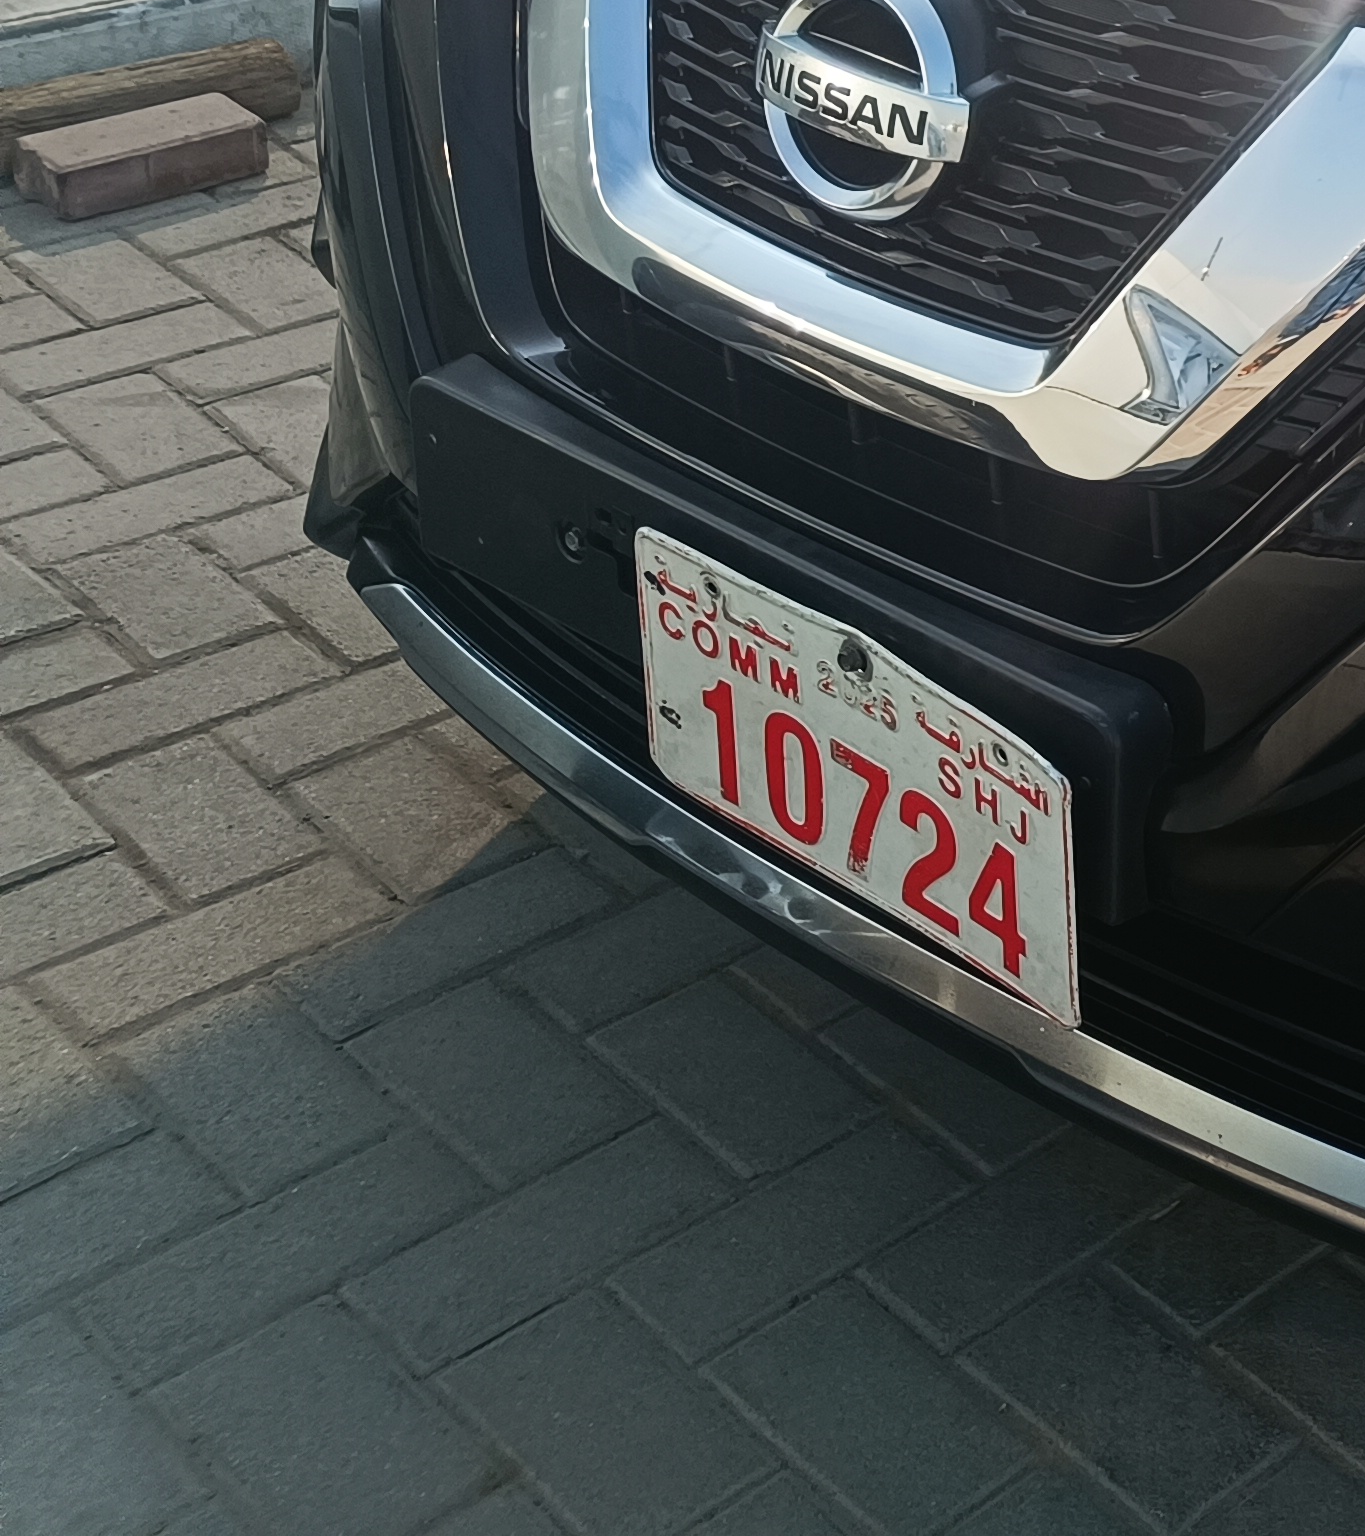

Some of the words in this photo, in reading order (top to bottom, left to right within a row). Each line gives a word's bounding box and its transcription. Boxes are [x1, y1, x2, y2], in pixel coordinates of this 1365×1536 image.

[760, 47, 929, 146] NISSAN
[658, 601, 803, 705] COMM
[910, 692, 1050, 817] الشارقة
[938, 754, 1031, 845] SHJ
[702, 678, 1028, 979] 10724
